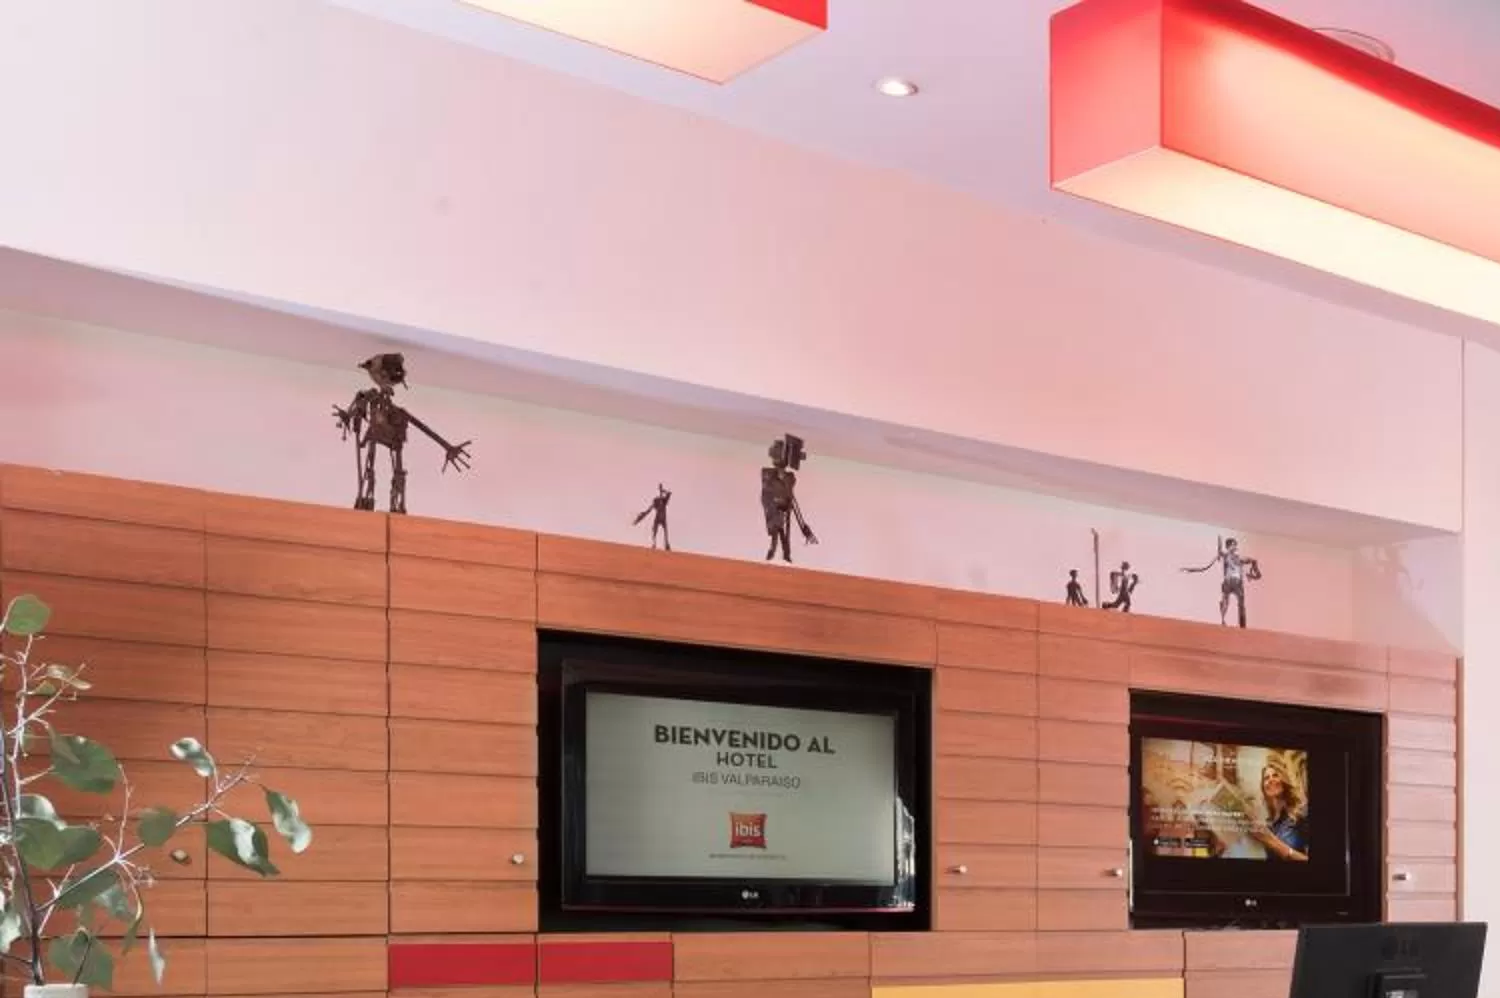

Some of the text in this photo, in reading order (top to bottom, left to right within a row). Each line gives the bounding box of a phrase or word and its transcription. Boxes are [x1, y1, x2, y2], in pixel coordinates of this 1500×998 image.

[654, 724, 836, 755] BIENVENIDO AL
[716, 751, 778, 769] HOTEL
[721, 772, 801, 789] VALPARAISO
[735, 822, 761, 837] ibis
